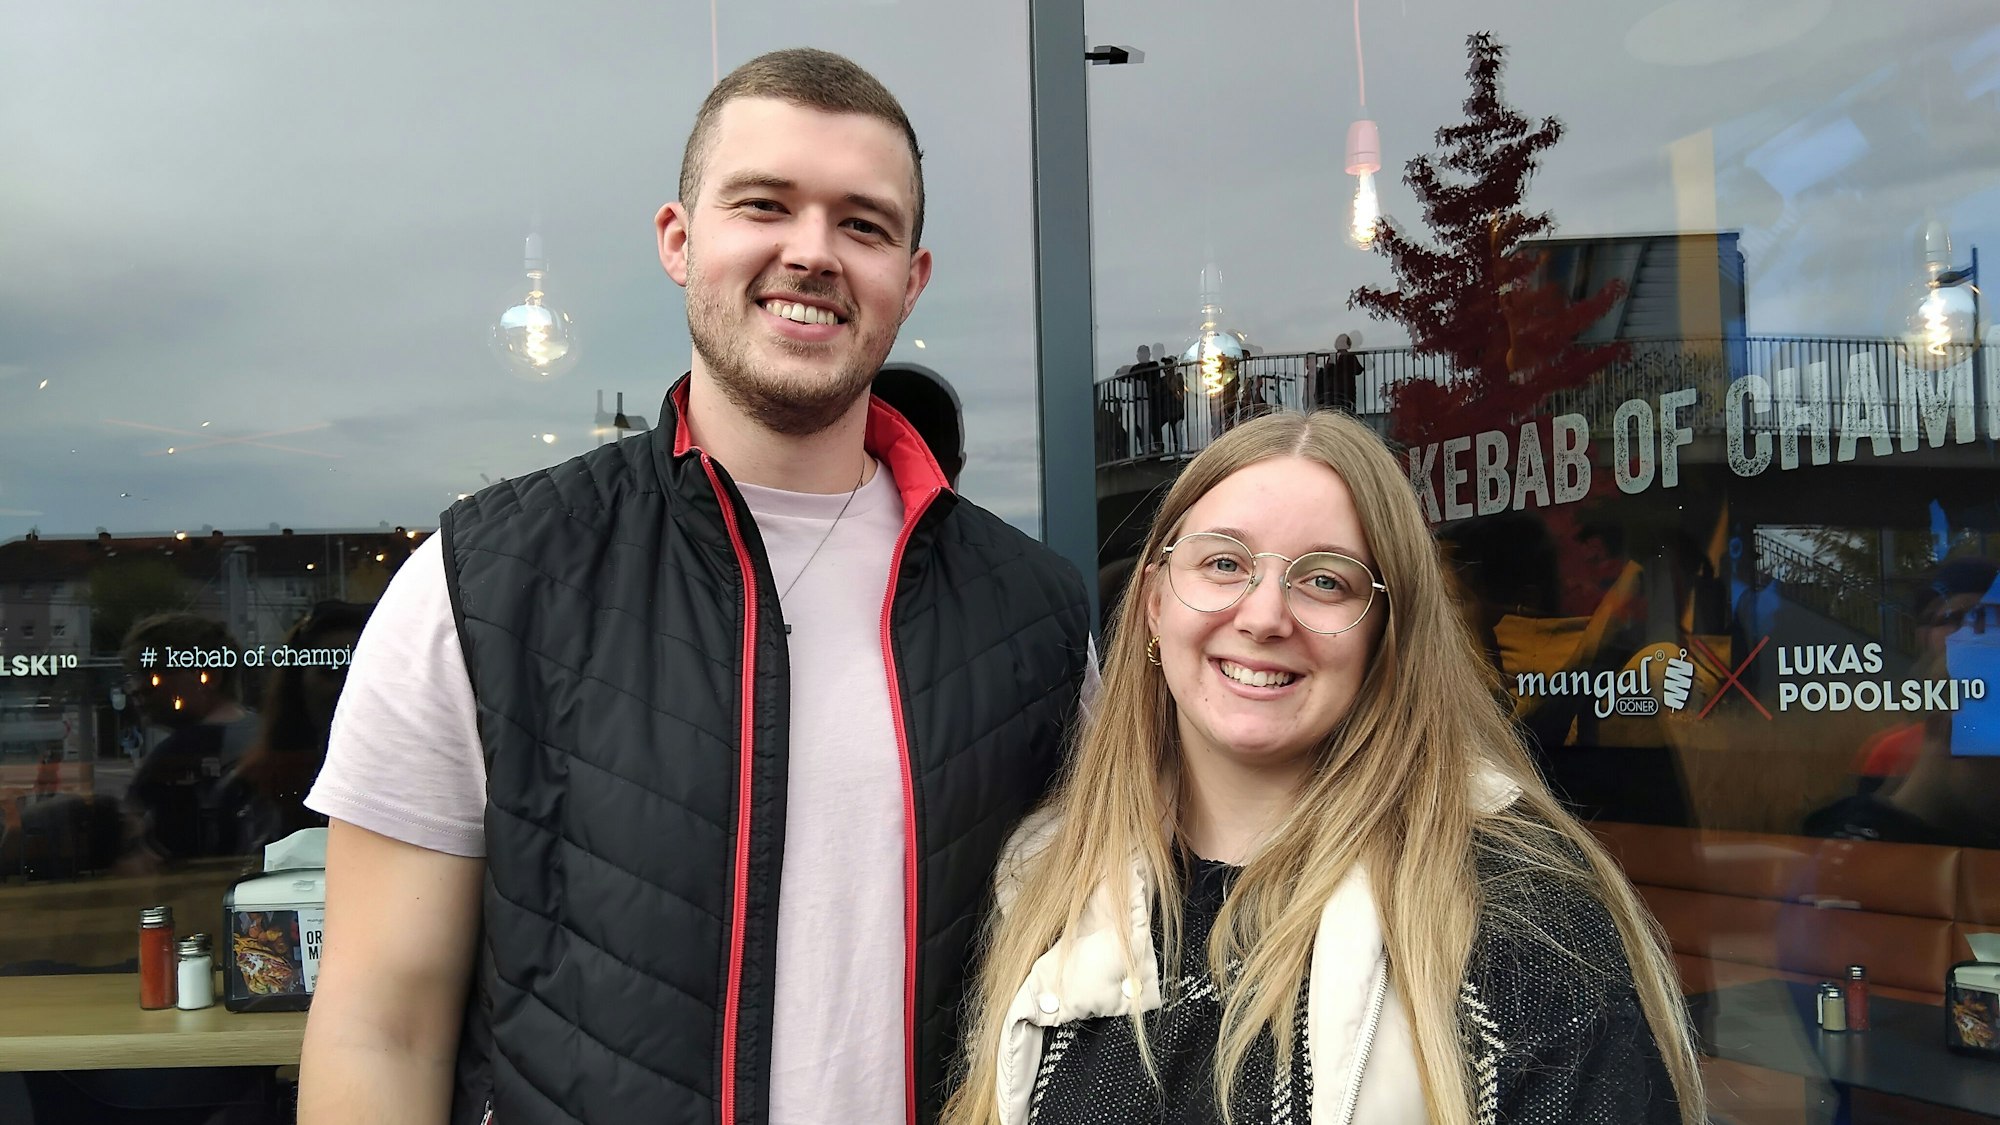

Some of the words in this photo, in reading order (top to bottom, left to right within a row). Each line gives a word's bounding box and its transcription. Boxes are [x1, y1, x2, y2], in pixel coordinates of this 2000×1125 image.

[1408, 413, 1592, 523] KEBAB
[1612, 387, 1698, 495] OF
[165, 646, 237, 668] kebab
[243, 645, 266, 667] of
[271, 643, 355, 670] champi
[1777, 642, 1884, 676] LUKAS
[1515, 655, 1654, 719] mangal
[1618, 697, 1656, 713] DÖNER
[306, 930, 324, 945] OR
